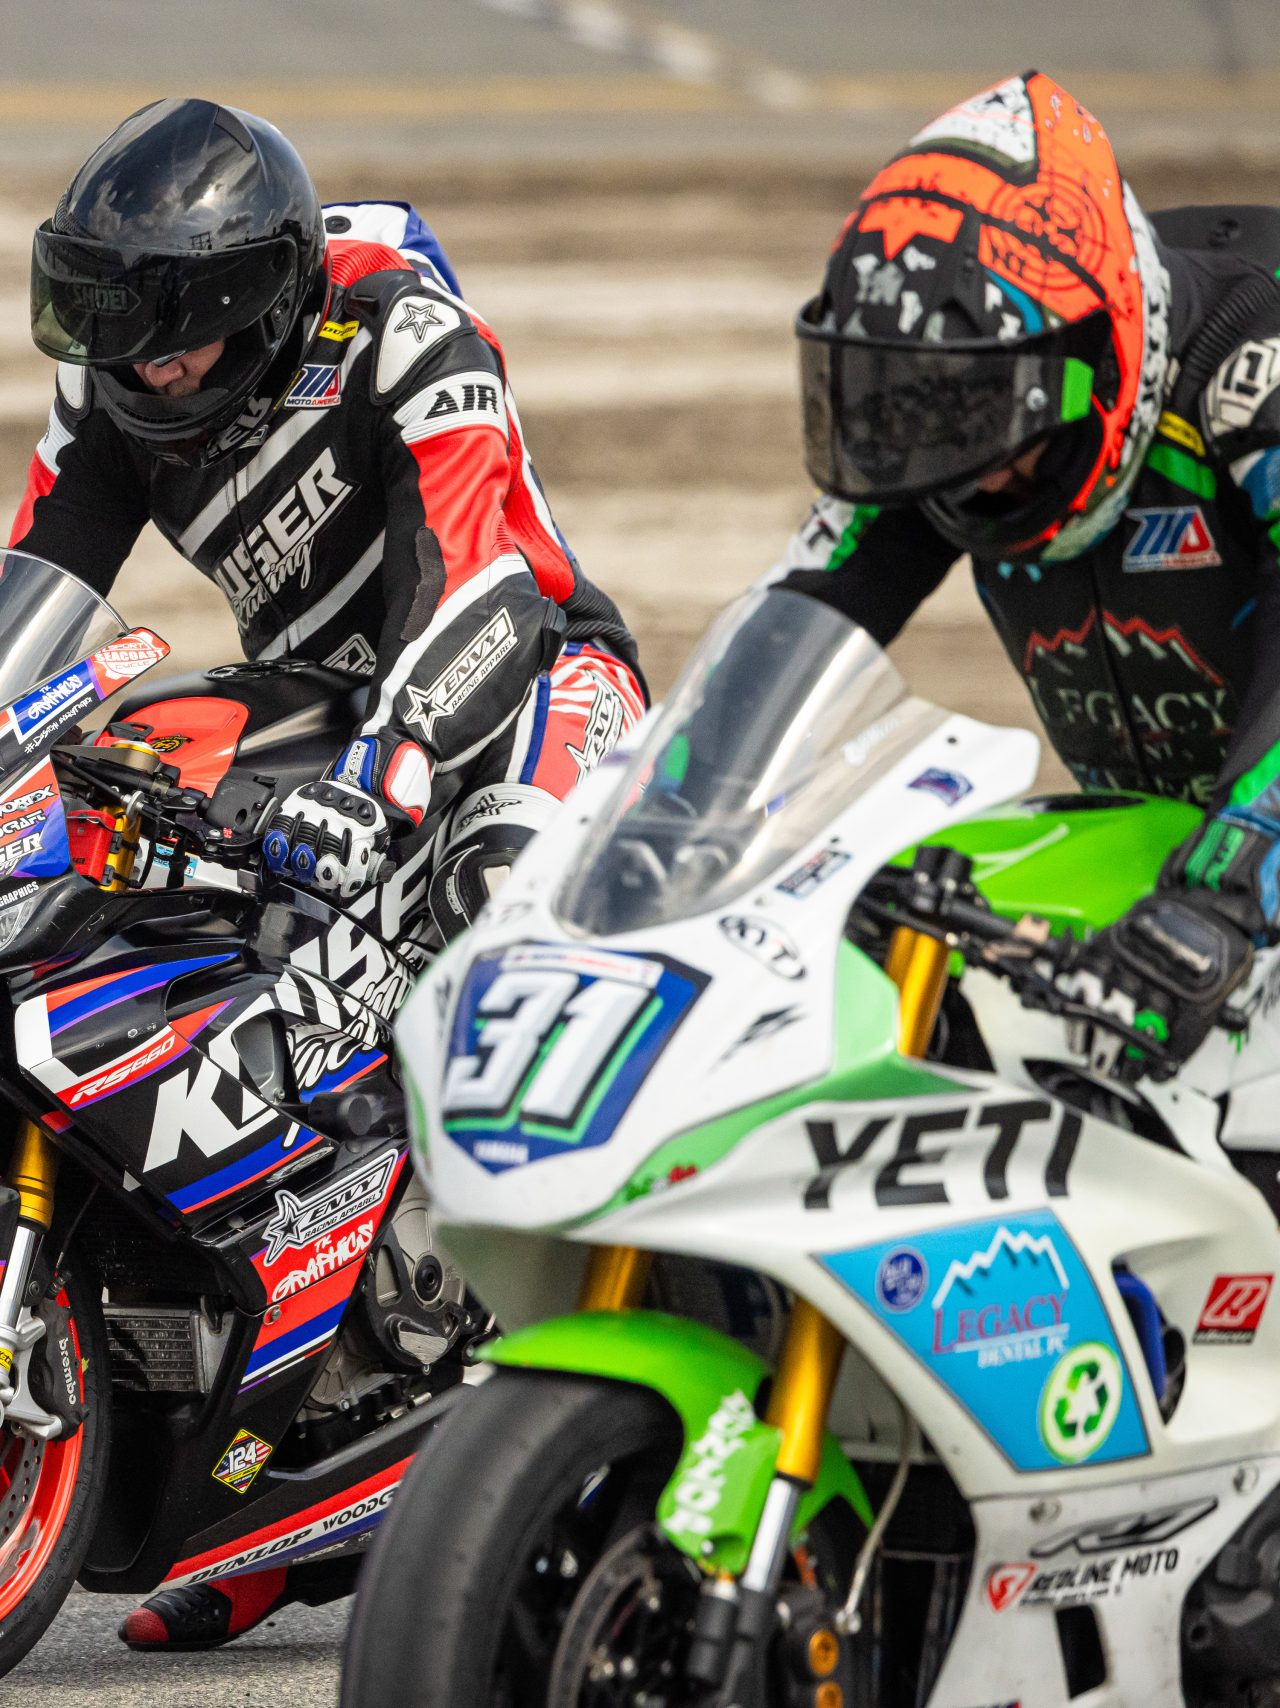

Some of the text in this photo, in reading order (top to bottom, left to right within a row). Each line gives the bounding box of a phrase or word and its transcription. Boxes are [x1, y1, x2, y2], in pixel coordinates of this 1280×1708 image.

[424, 384, 498, 420] AIR
[95, 649, 164, 662] SEACOAST
[115, 660, 151, 670] CYCLE
[442, 626, 499, 695] ENVY
[480, 640, 513, 679] APPAREL
[39, 685, 52, 695] TK
[451, 676, 480, 710] RACING
[444, 971, 654, 1119] 31
[69, 1034, 176, 1105] RS660
[803, 1100, 1083, 1210] YETI
[304, 1195, 377, 1239] RACING APPAREL
[308, 1174, 377, 1223] ENVY
[272, 1219, 374, 1303] GRAPHICS
[314, 1233, 333, 1252] TK
[931, 1291, 1067, 1355] LEGACY
[58, 1337, 77, 1405] brembo
[228, 1440, 257, 1473] 124
[184, 1486, 395, 1586] DUNLOP WOODC
[1121, 1549, 1179, 1579] MOTO
